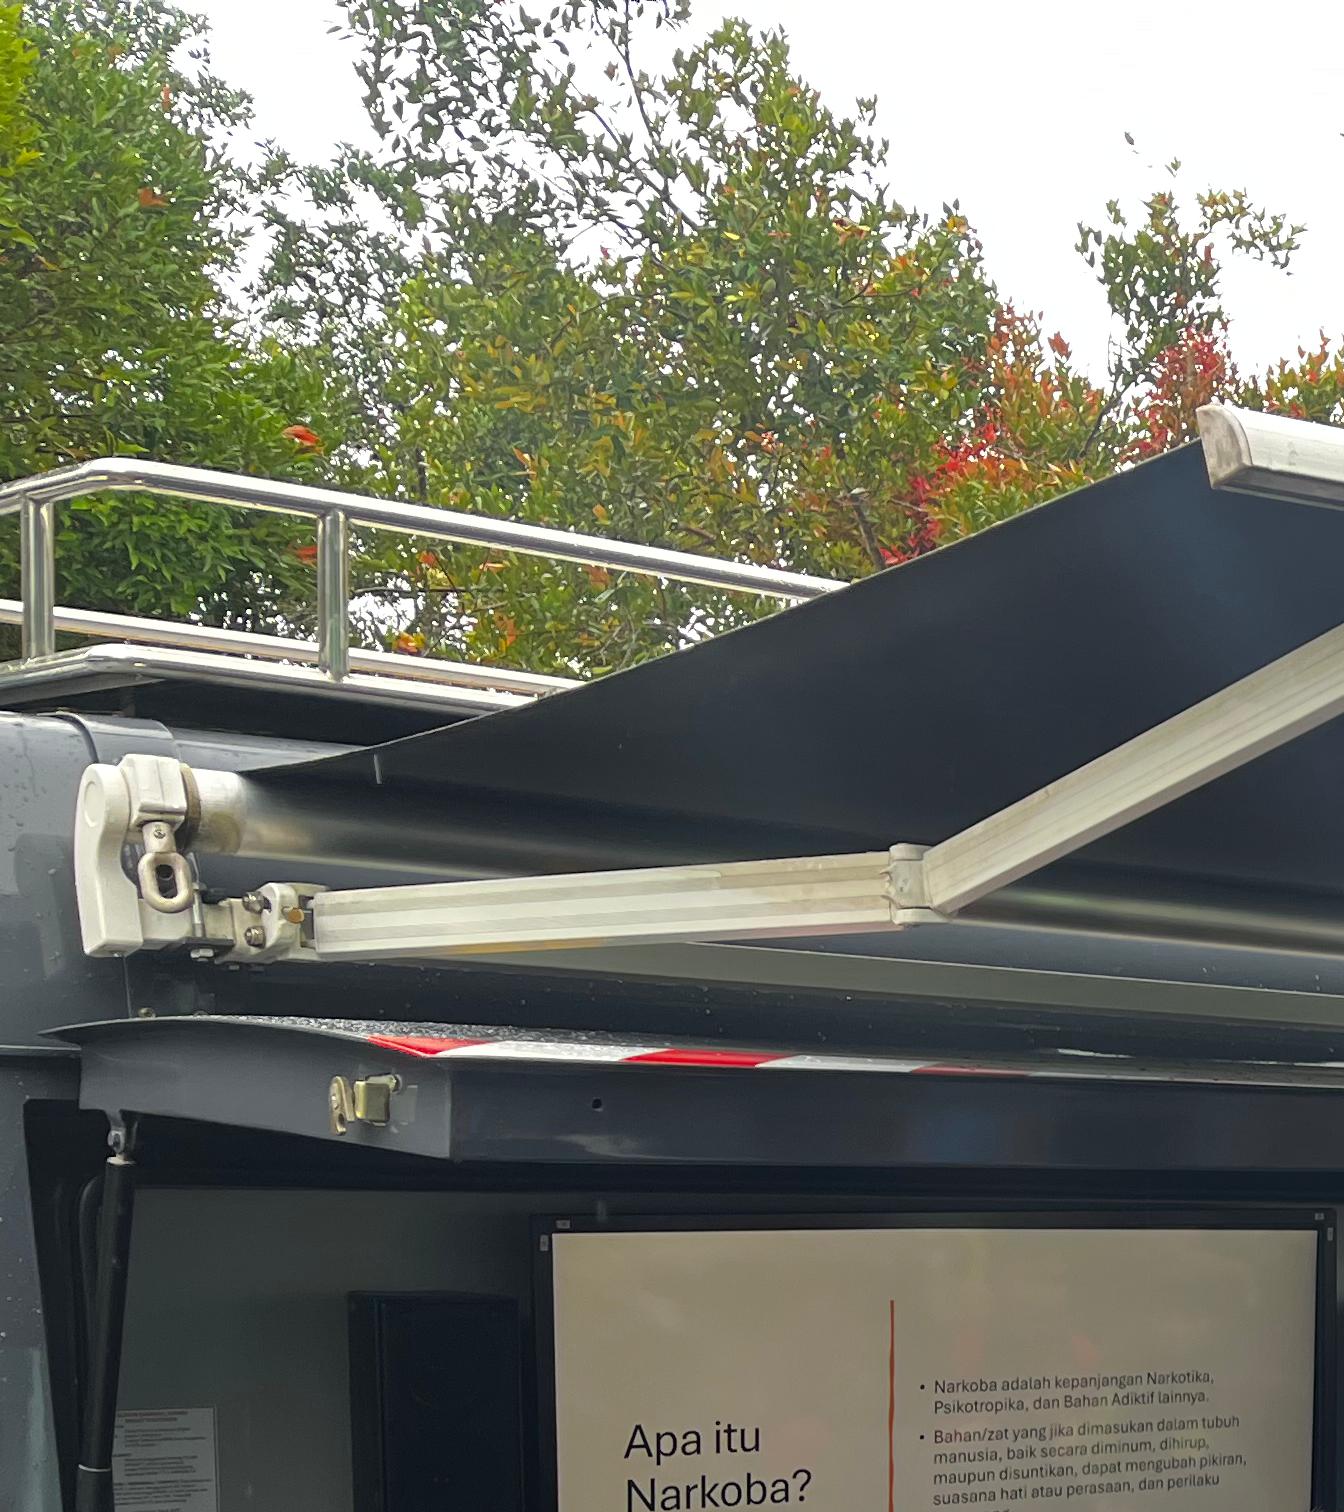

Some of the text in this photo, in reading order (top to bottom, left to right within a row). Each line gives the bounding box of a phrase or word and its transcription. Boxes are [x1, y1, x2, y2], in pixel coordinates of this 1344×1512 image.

[934, 1370, 1214, 1394] Narkoba adalah kepanjangan Narkotika,
[934, 1390, 1209, 1415] Psikotropika, dan Bahan Adiktif lainnya.
[624, 1420, 760, 1466] Apa itu
[934, 1416, 1240, 1444] Bahan/zat yang jika dimasukan dalam tubuh
[933, 1437, 1209, 1464] manusia, baik secara diminum, dihirup,
[933, 1453, 1247, 1485] maupun disuntikan, dapat mengubah pikiran,
[627, 1468, 812, 1512] Narkoba?
[933, 1474, 1220, 1506] suasana hati atau perasaan, dan perilaku
